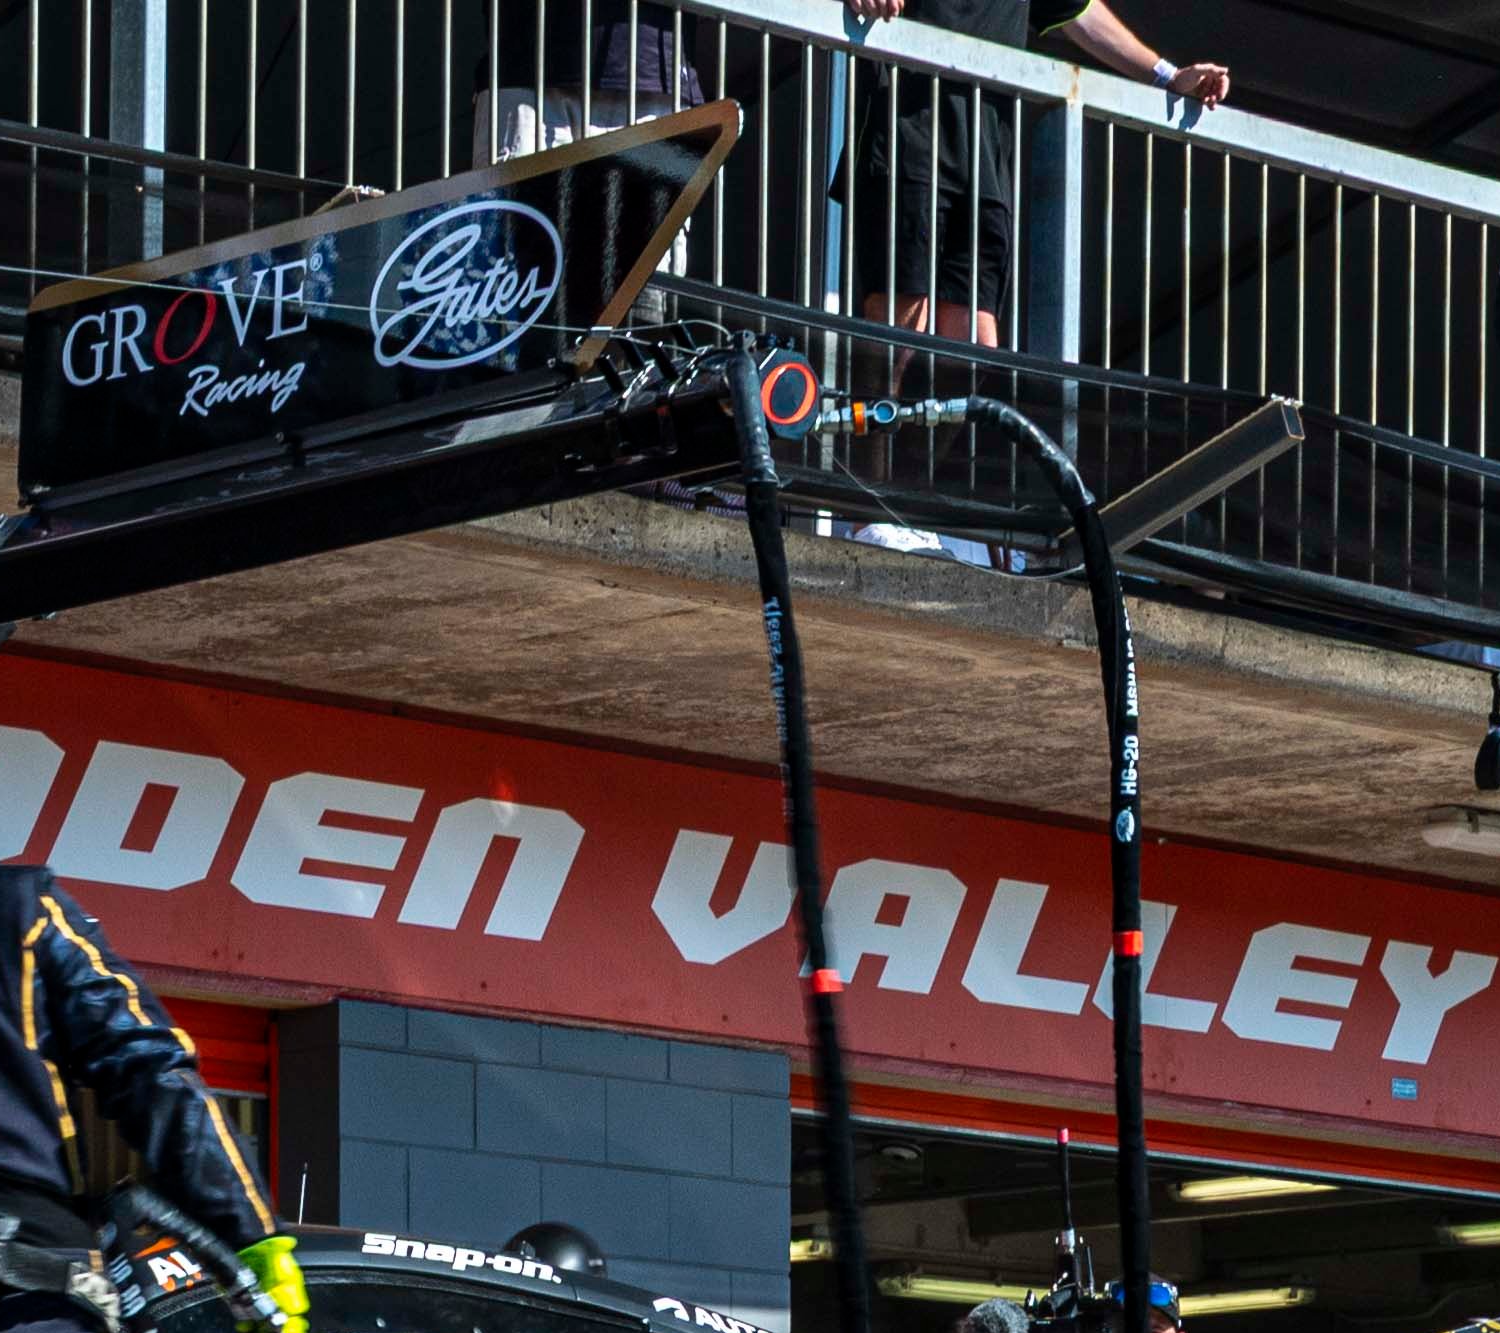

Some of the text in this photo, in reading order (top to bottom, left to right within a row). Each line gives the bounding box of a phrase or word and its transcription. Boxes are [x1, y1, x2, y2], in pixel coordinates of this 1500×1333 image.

[390, 218, 552, 360] Gates
[178, 359, 306, 417] Racing
[1120, 734, 1140, 796] HG-20
[650, 827, 1498, 1065] VALLEY
